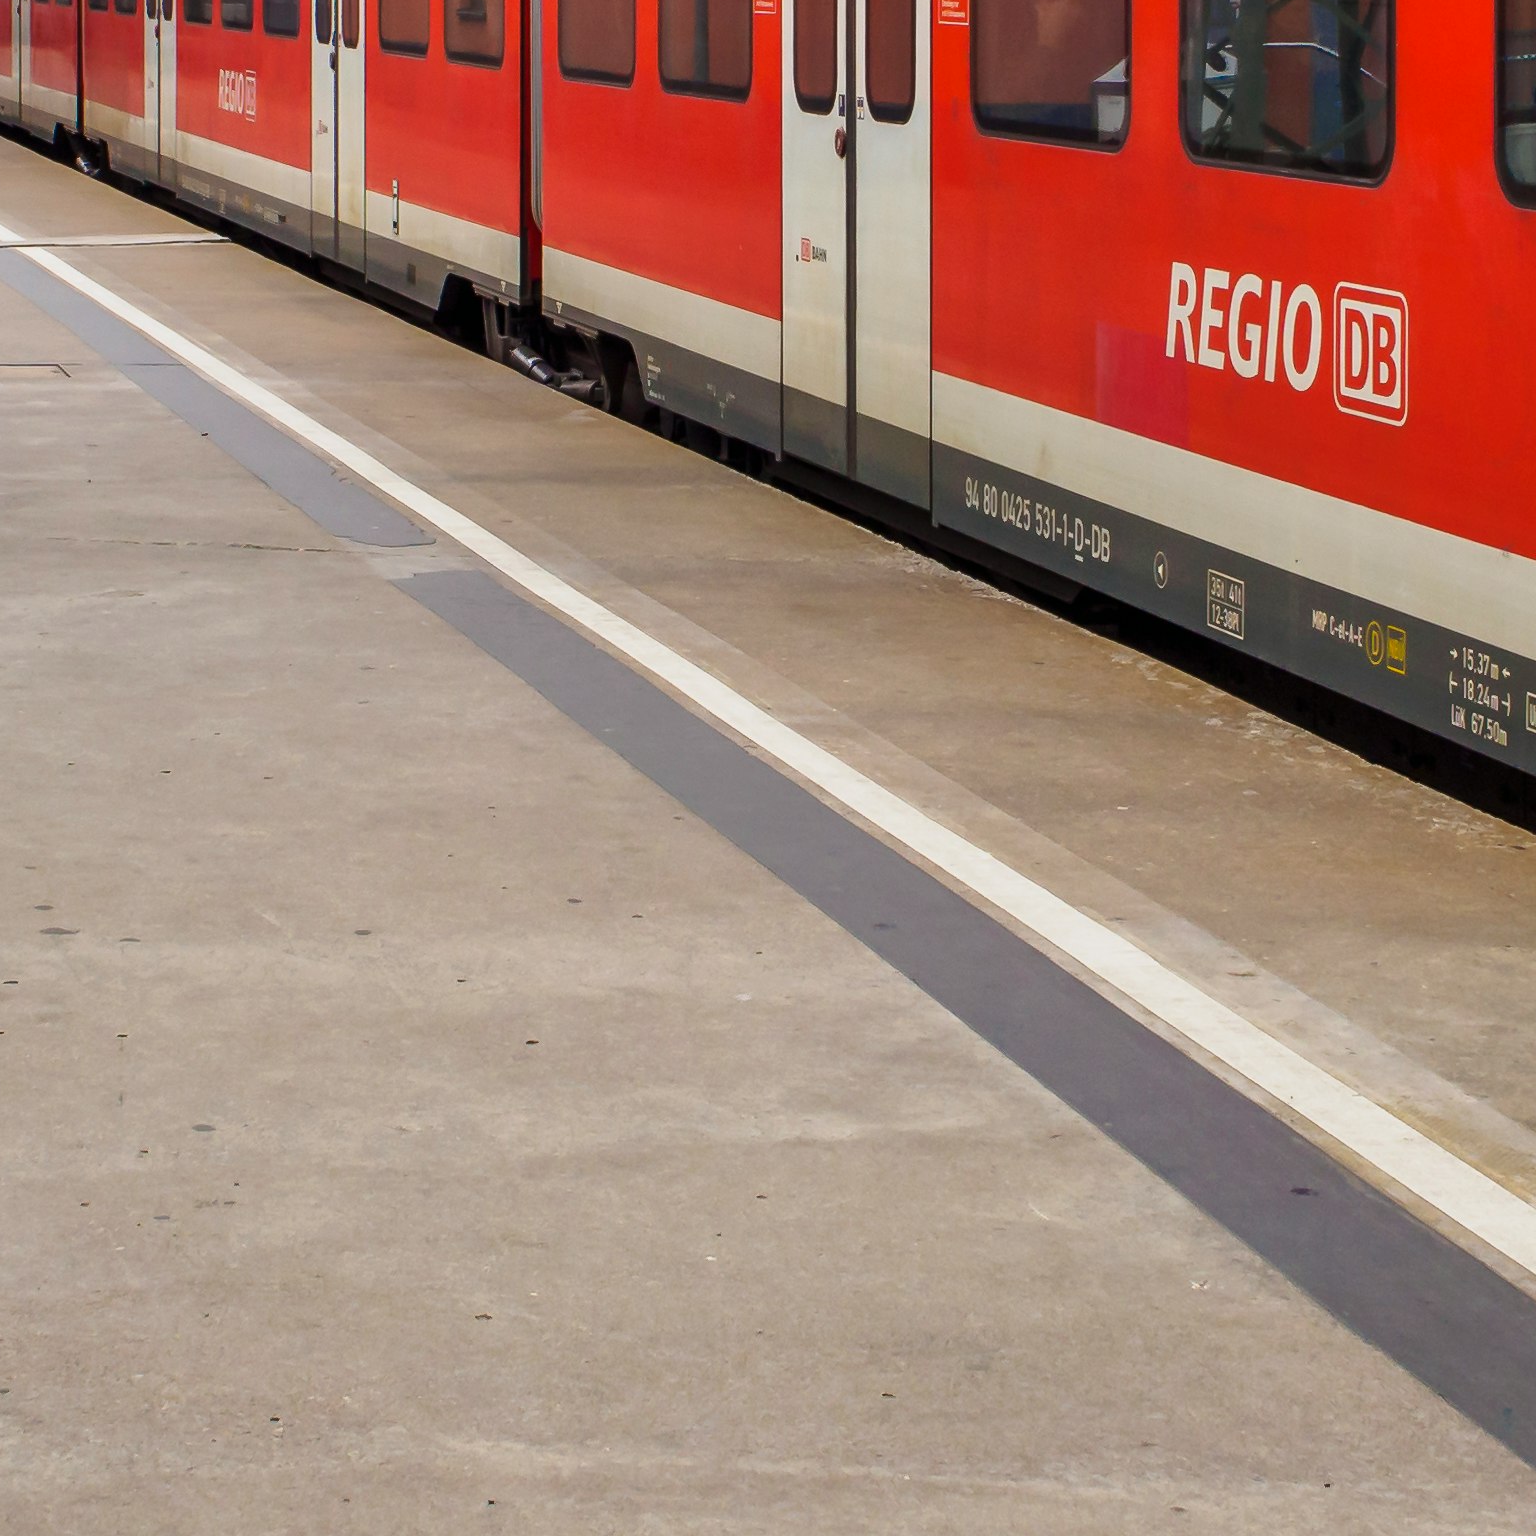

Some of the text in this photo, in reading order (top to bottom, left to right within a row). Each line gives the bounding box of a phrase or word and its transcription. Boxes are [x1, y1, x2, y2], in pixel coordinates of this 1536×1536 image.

[1165, 261, 1399, 400] REGIO DB
[965, 476, 1111, 563] 94 80 0425 531-1-D-DB
